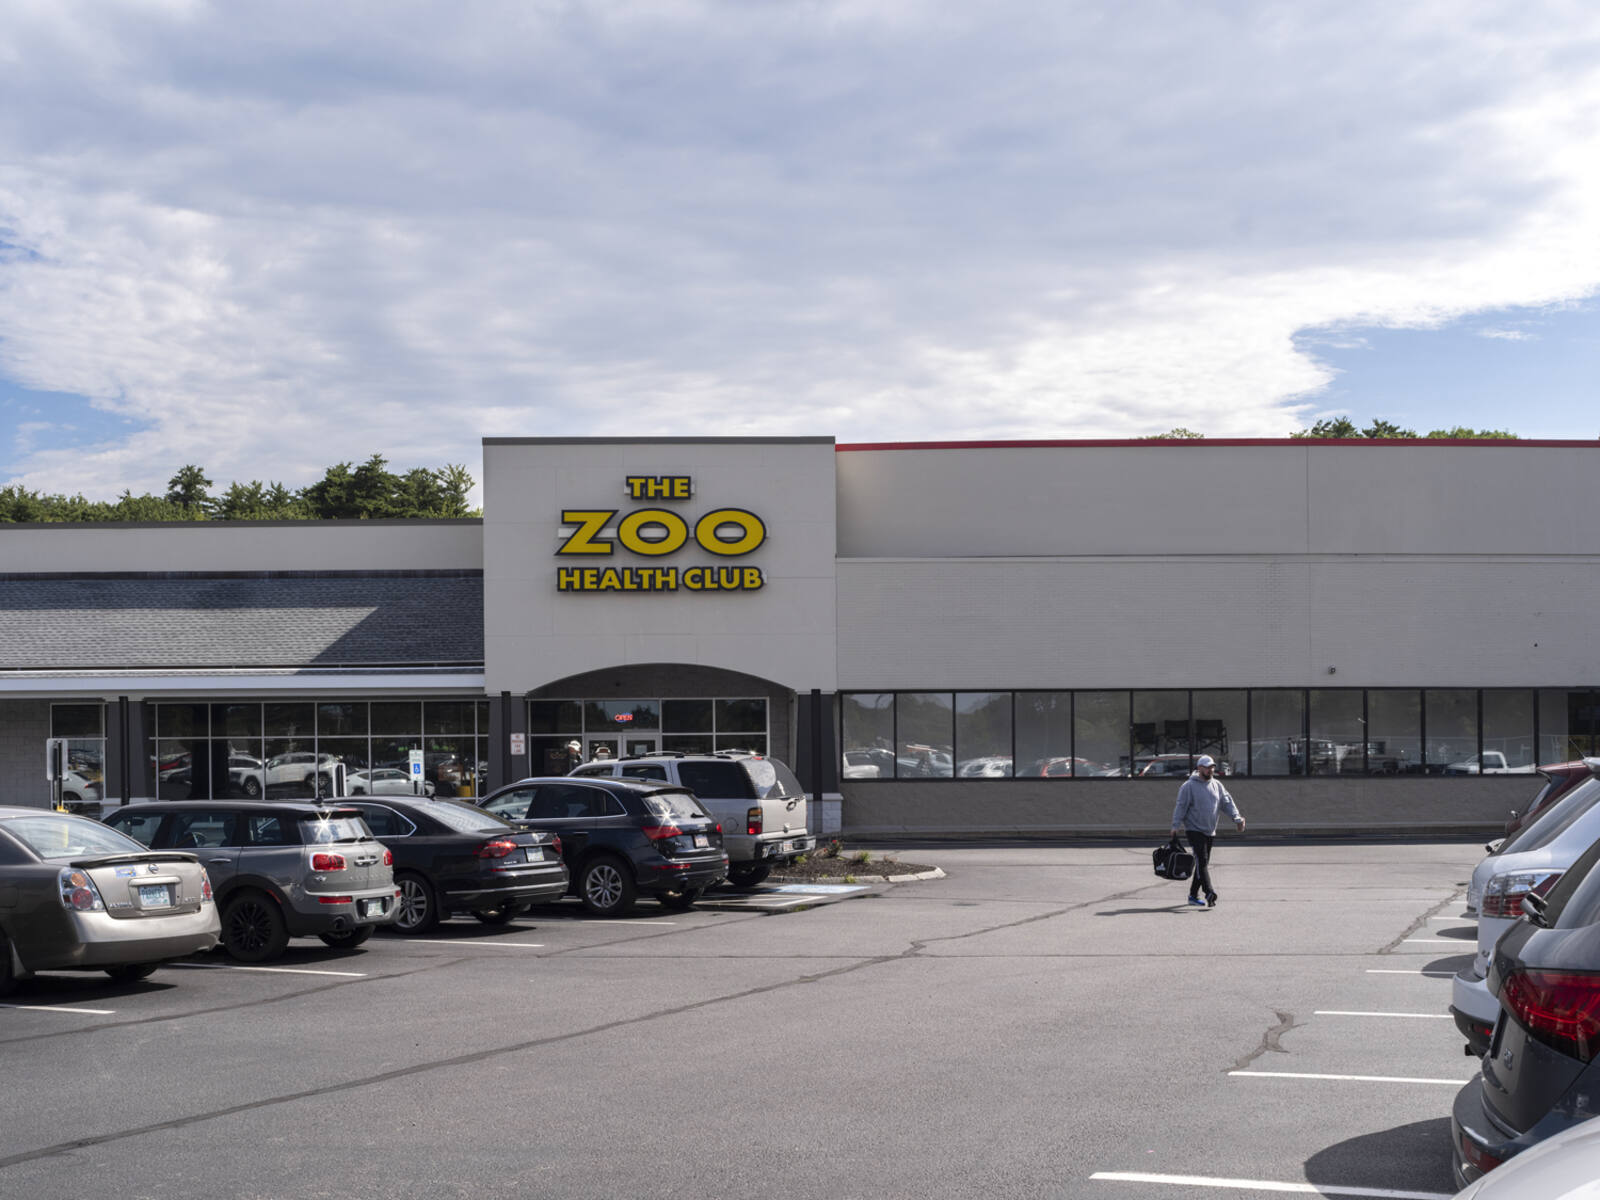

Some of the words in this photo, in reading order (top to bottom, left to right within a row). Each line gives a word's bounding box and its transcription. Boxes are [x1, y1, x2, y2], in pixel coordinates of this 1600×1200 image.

[626, 476, 691, 500] THE
[555, 508, 767, 557] ZOO
[557, 567, 679, 592] HEALTH
[683, 566, 764, 592] CLUB
